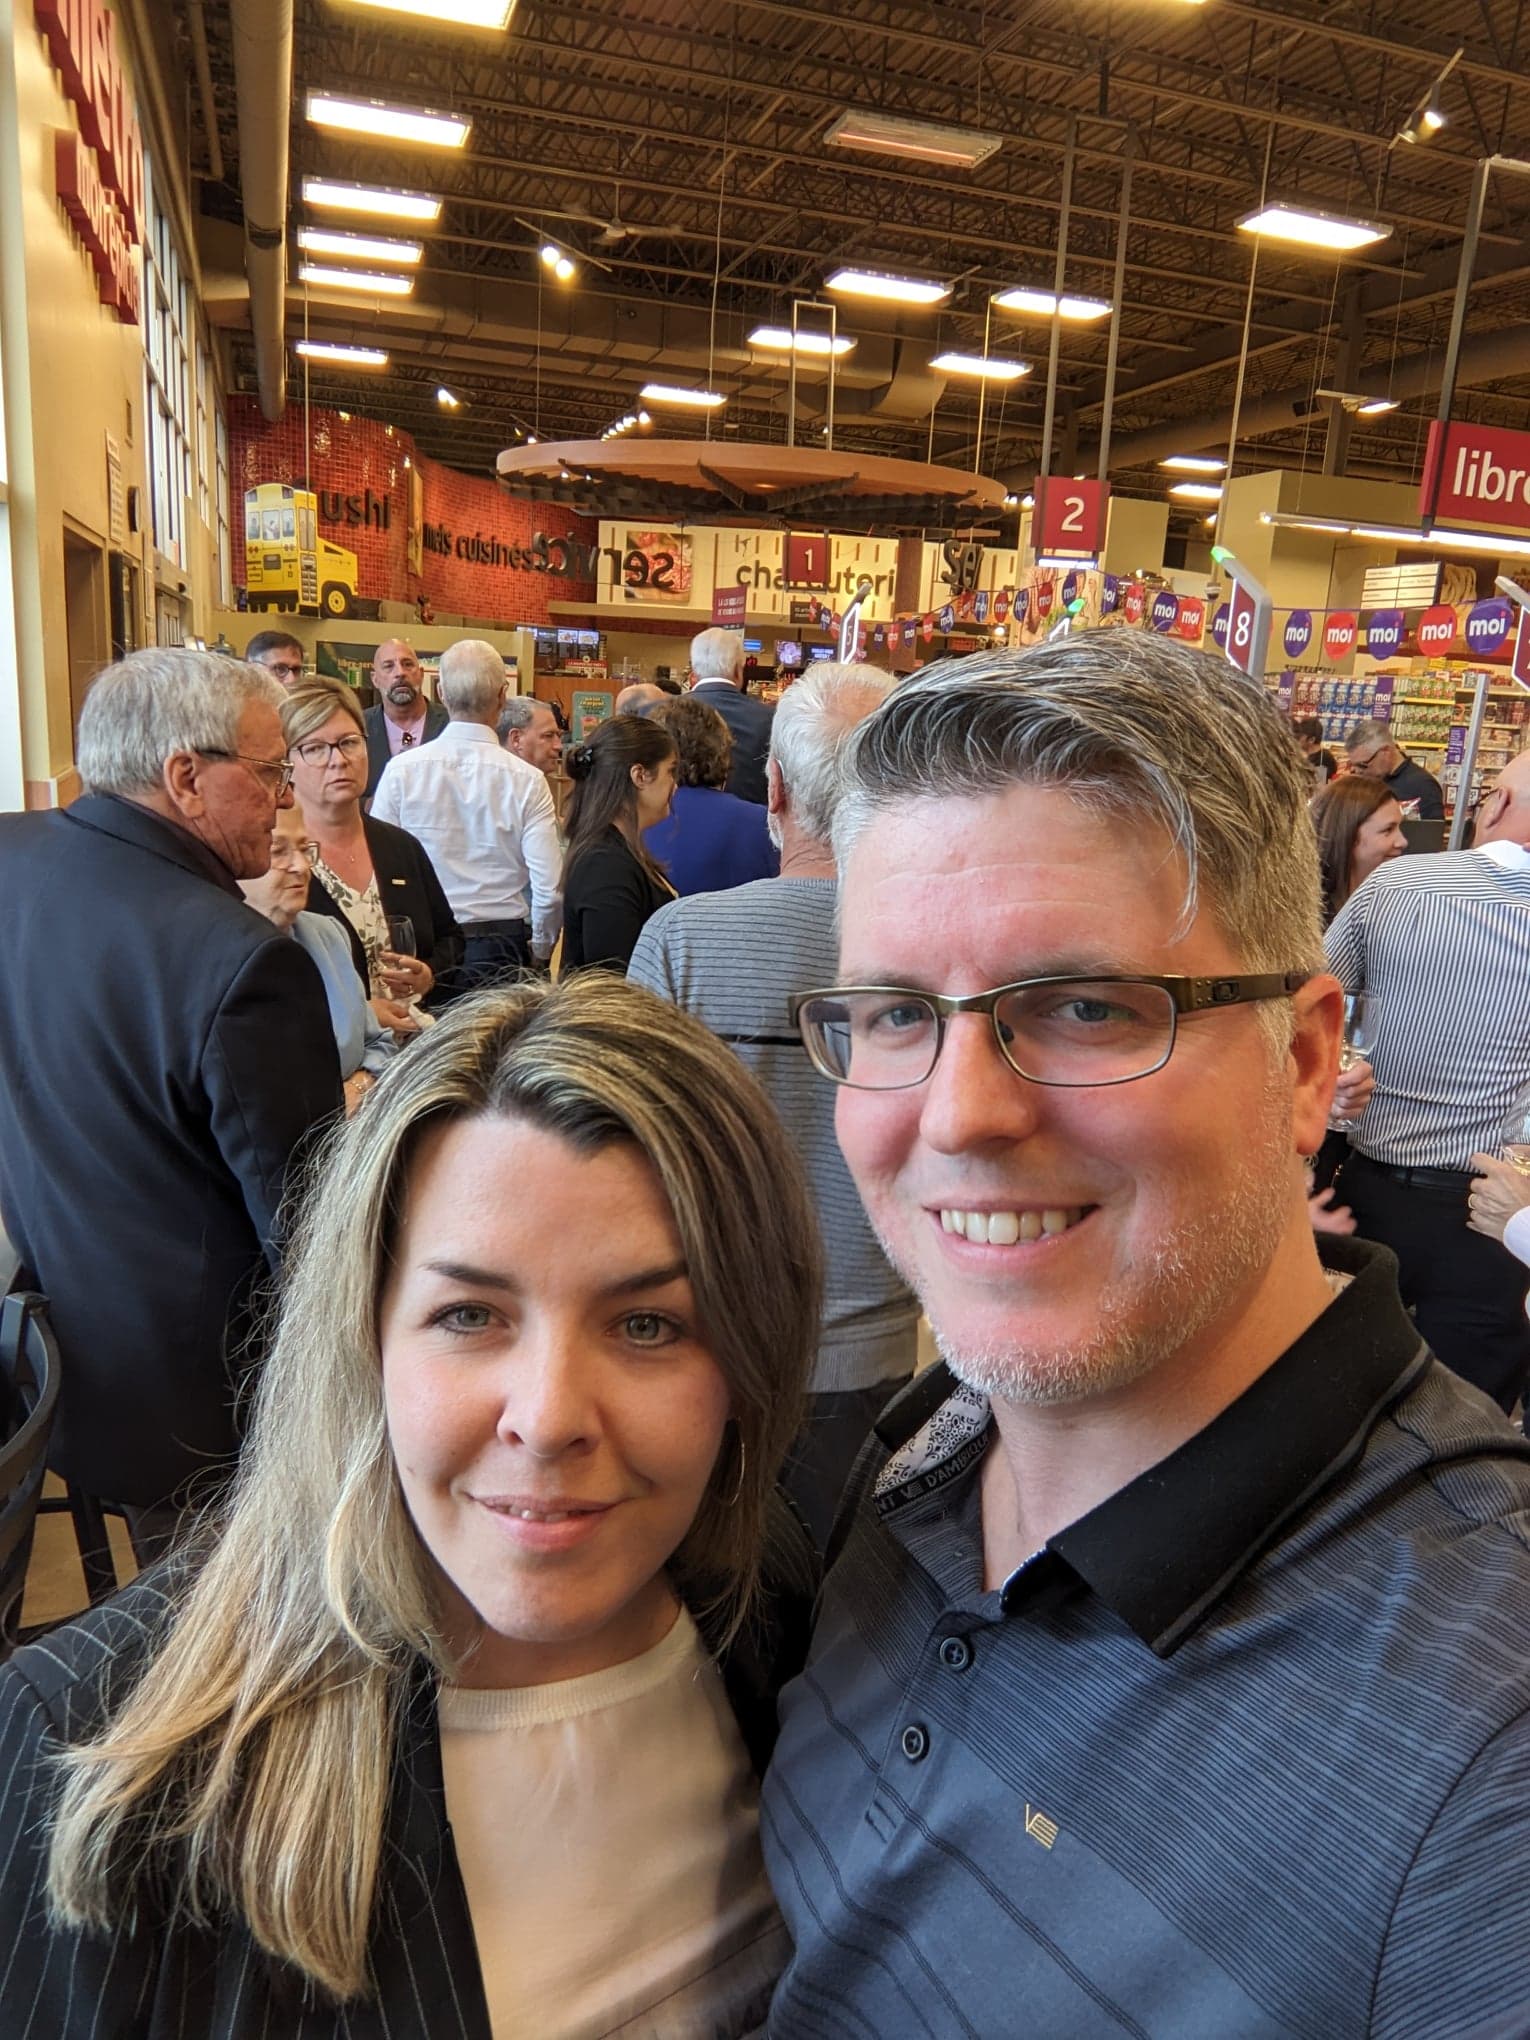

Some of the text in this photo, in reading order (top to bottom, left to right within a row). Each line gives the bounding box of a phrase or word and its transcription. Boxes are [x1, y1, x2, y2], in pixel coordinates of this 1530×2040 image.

[321, 488, 391, 529] ushi
[1061, 497, 1085, 532] 2
[804, 549, 813, 571] 1
[736, 559, 894, 597] chauteri
[1154, 601, 1176, 619] moi
[1182, 609, 1200, 625] moi
[1235, 612, 1250, 646] 8
[1286, 622, 1309, 642] moi
[1327, 624, 1354, 643] moi
[1369, 621, 1399, 643] moi
[1422, 617, 1453, 640] moi
[1469, 610, 1506, 636] moi
[1375, 692, 1391, 702] moi
